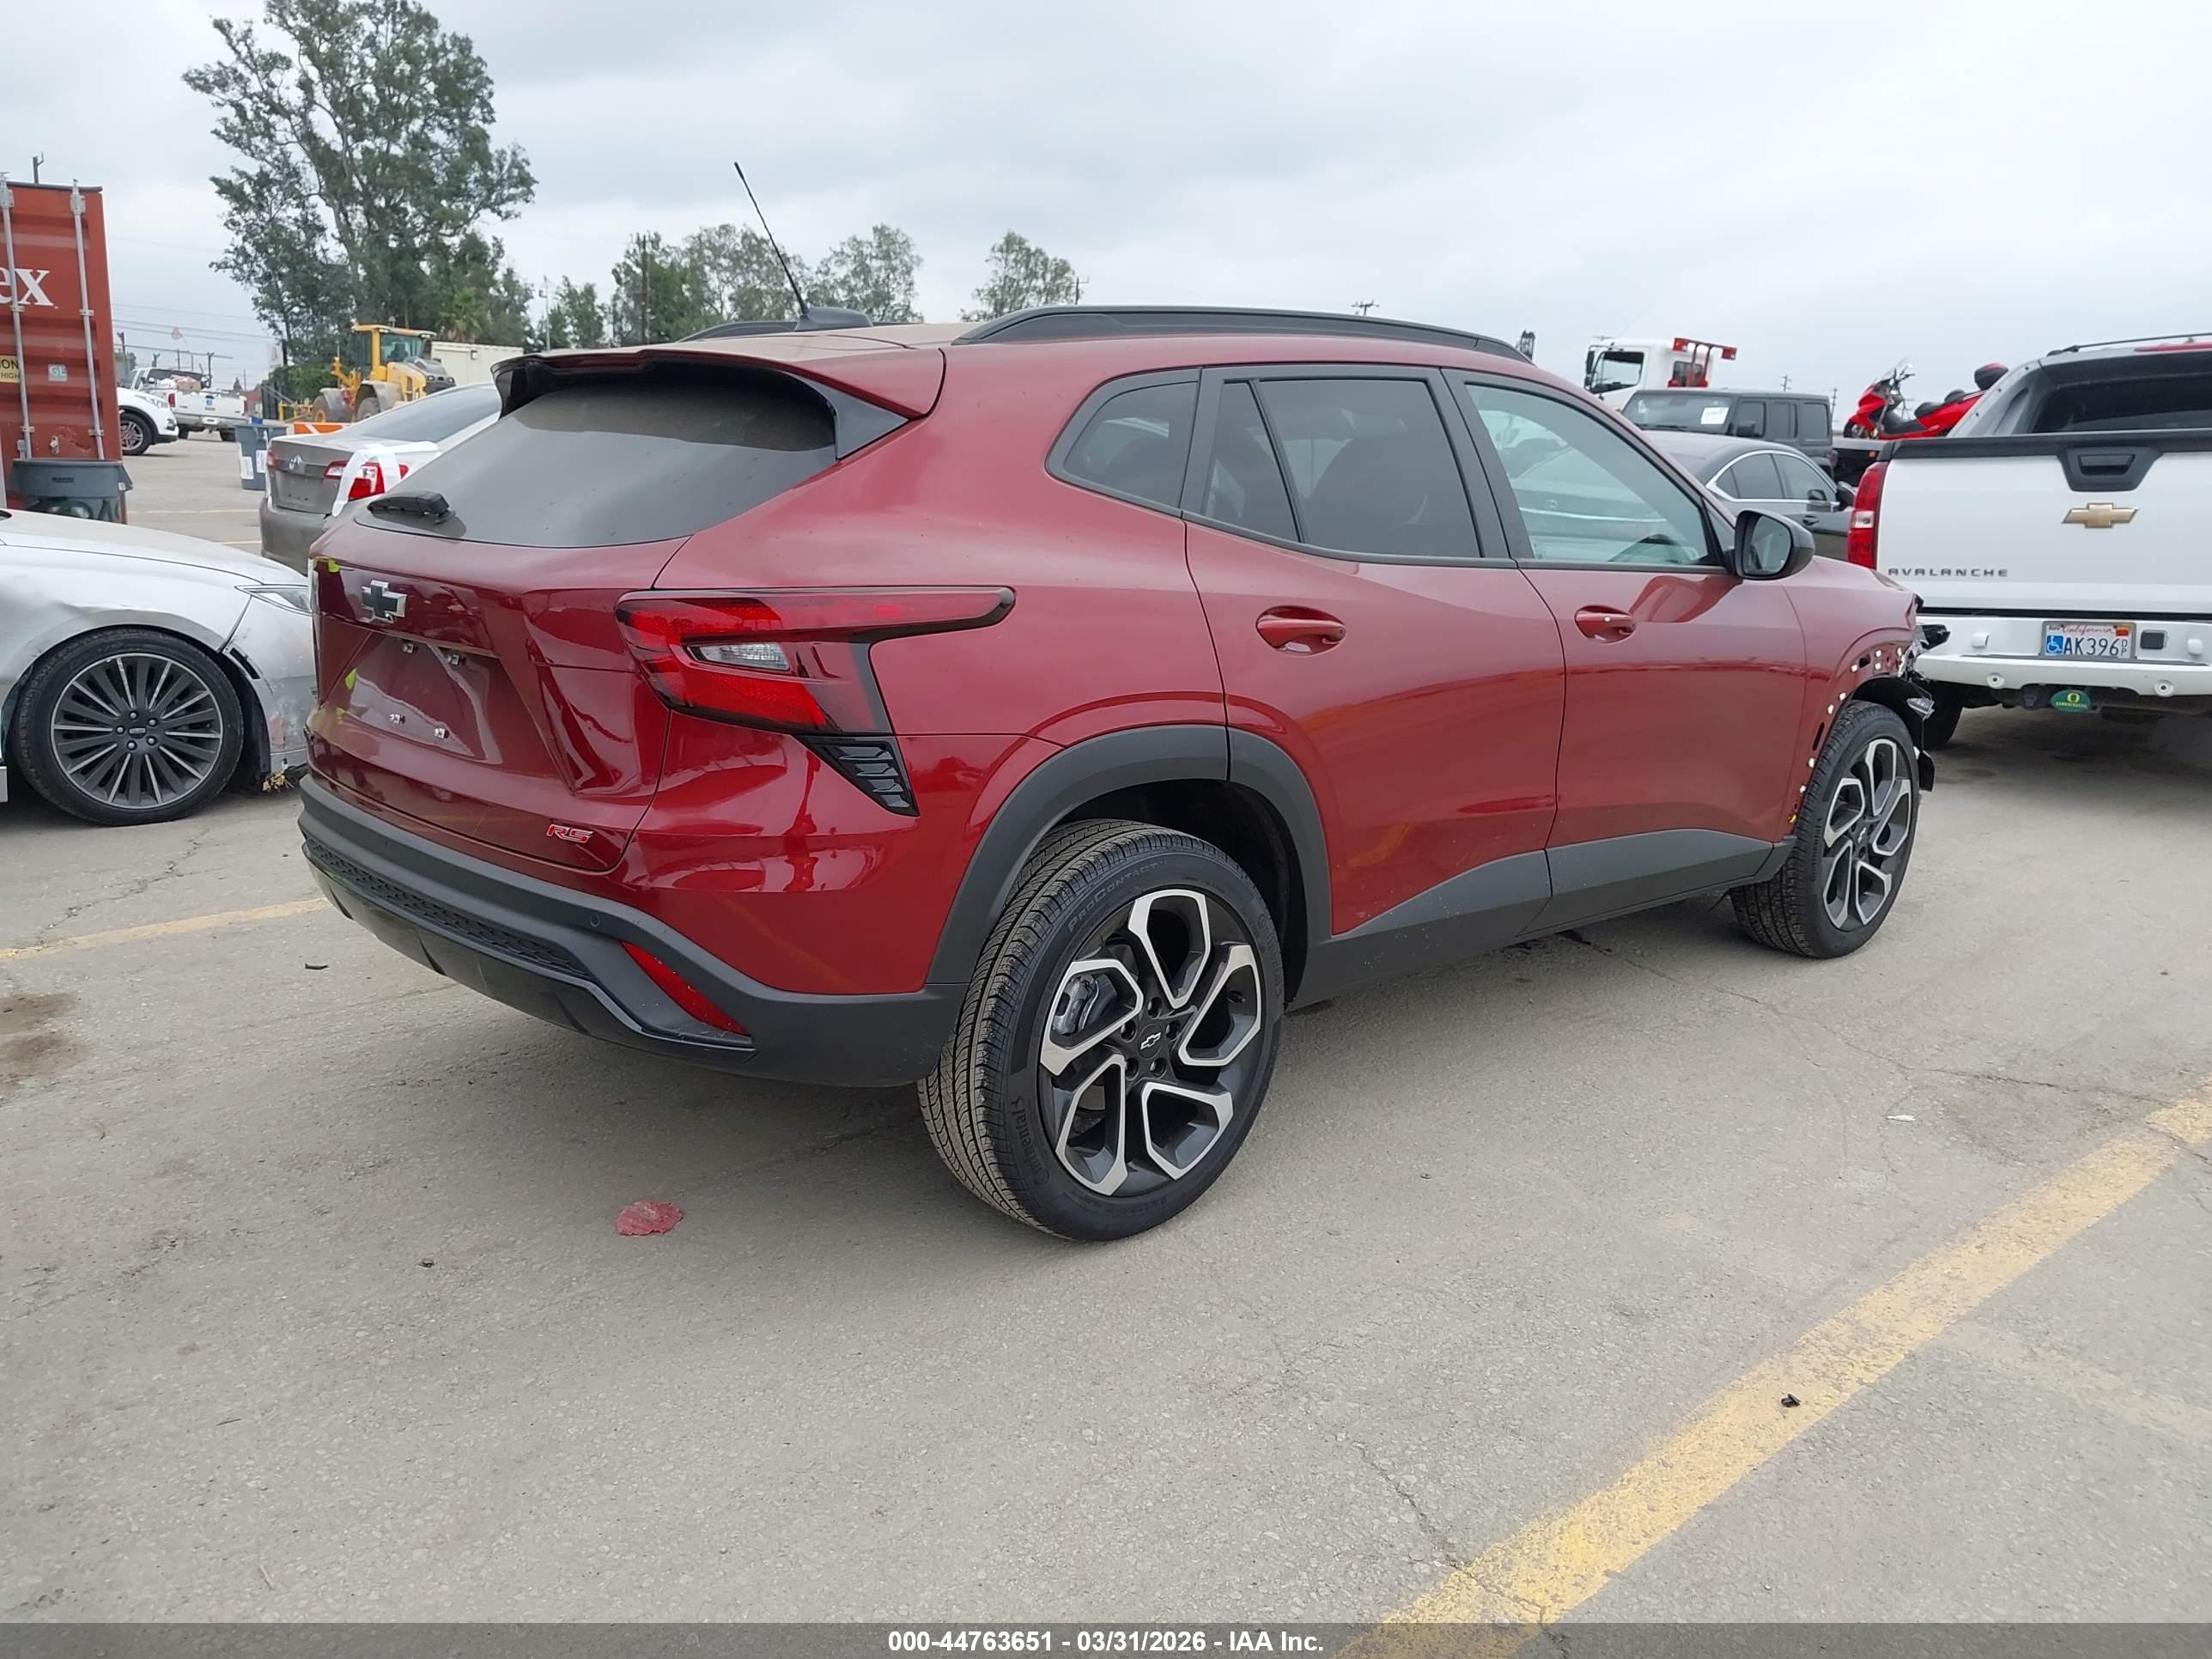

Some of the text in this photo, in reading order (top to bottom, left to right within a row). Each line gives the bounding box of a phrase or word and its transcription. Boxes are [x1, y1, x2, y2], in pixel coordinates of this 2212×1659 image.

[1887, 568, 2008, 577] AVALANCHE
[2063, 637, 2119, 656] AK396
[546, 824, 593, 843] RS
